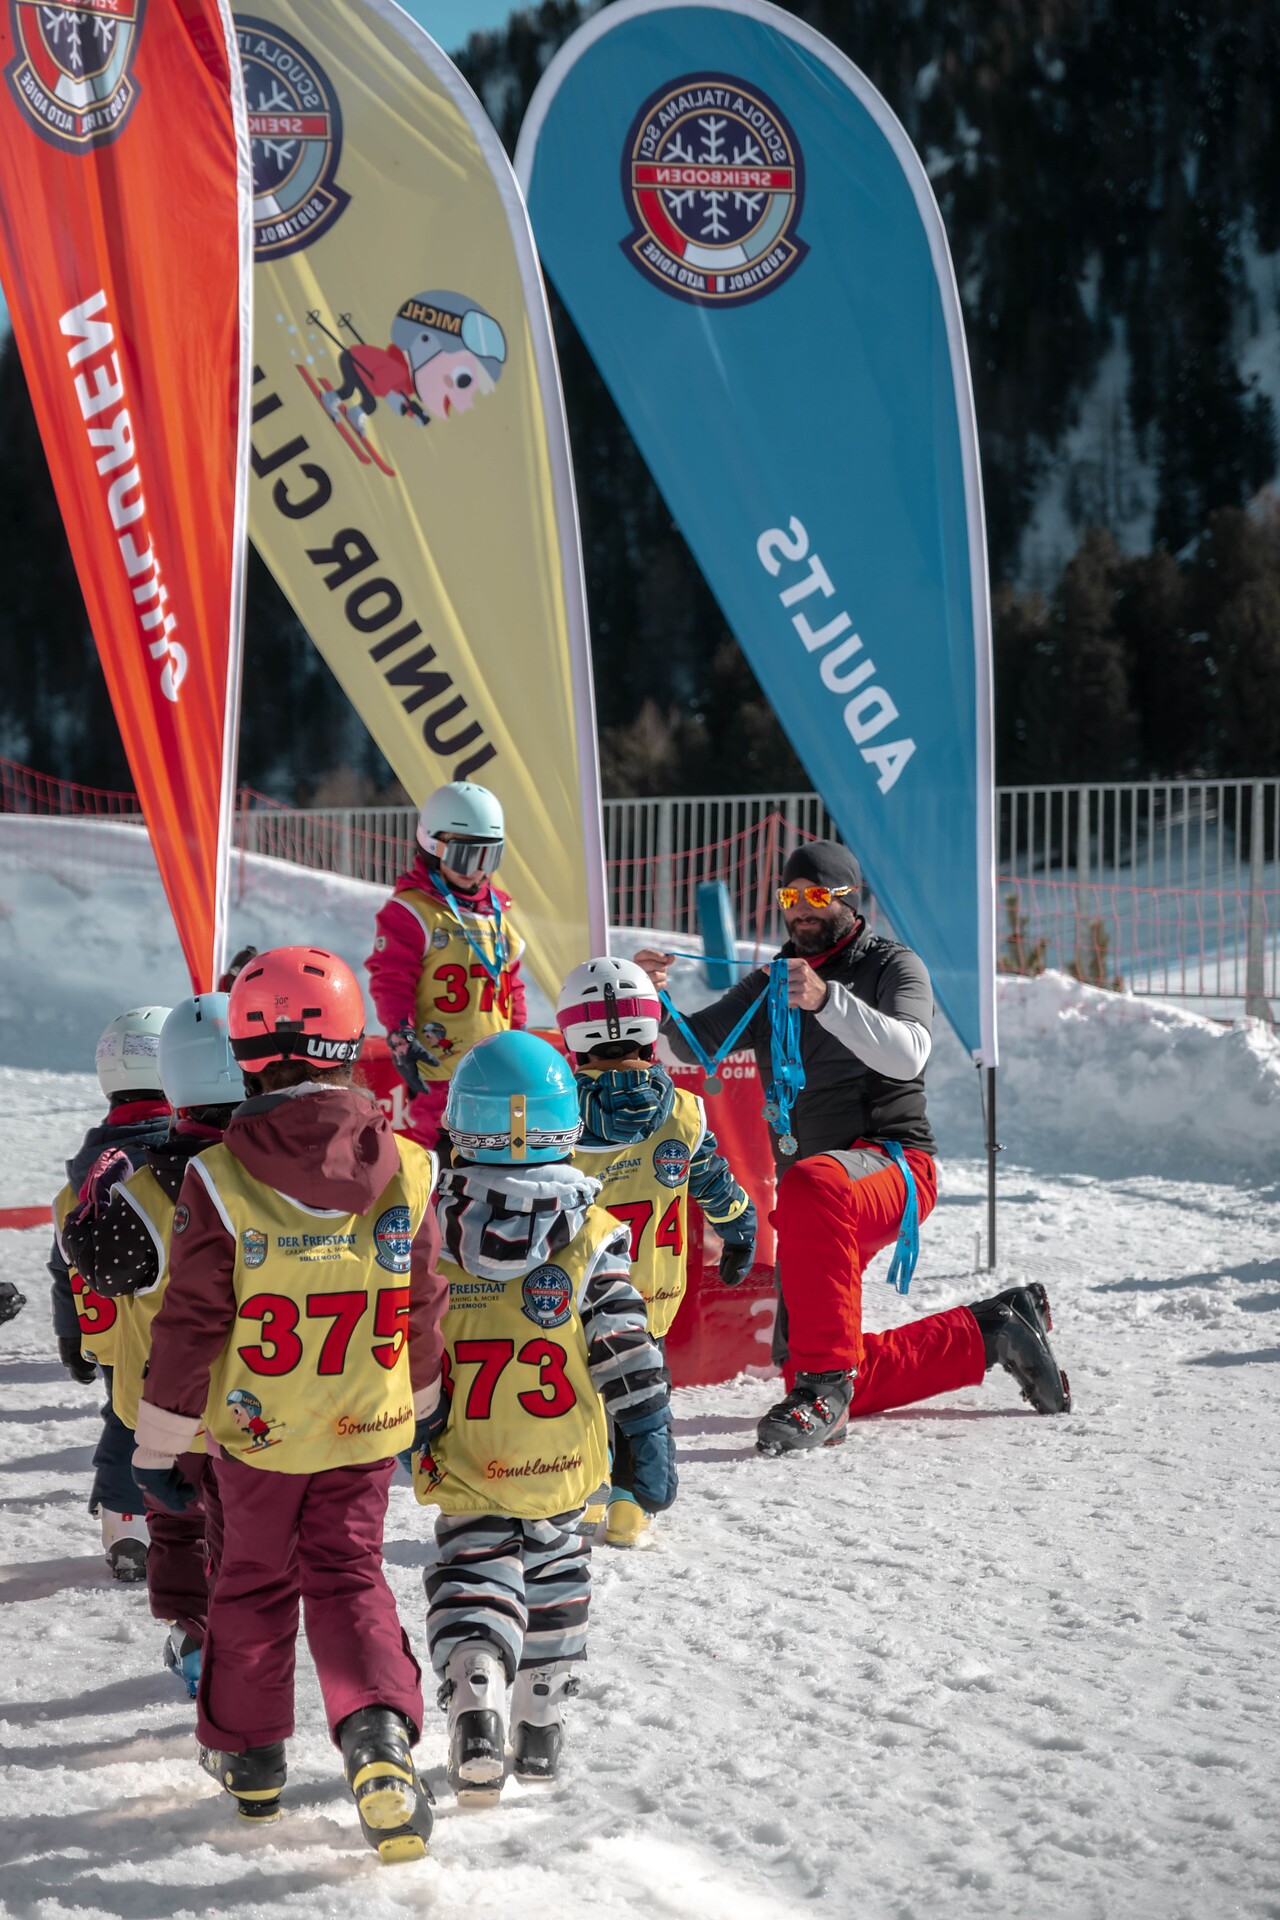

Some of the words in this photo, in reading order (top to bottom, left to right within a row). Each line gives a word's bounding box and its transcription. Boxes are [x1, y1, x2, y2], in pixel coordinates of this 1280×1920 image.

[307, 1038, 360, 1060] uvex
[722, 1066, 756, 1079] OGM
[605, 1196, 683, 1263] 74
[278, 1237, 299, 1247] DER
[302, 1234, 357, 1247] FREISTAAT
[449, 1283, 507, 1295] FREISTAAT
[237, 1286, 411, 1377] 375
